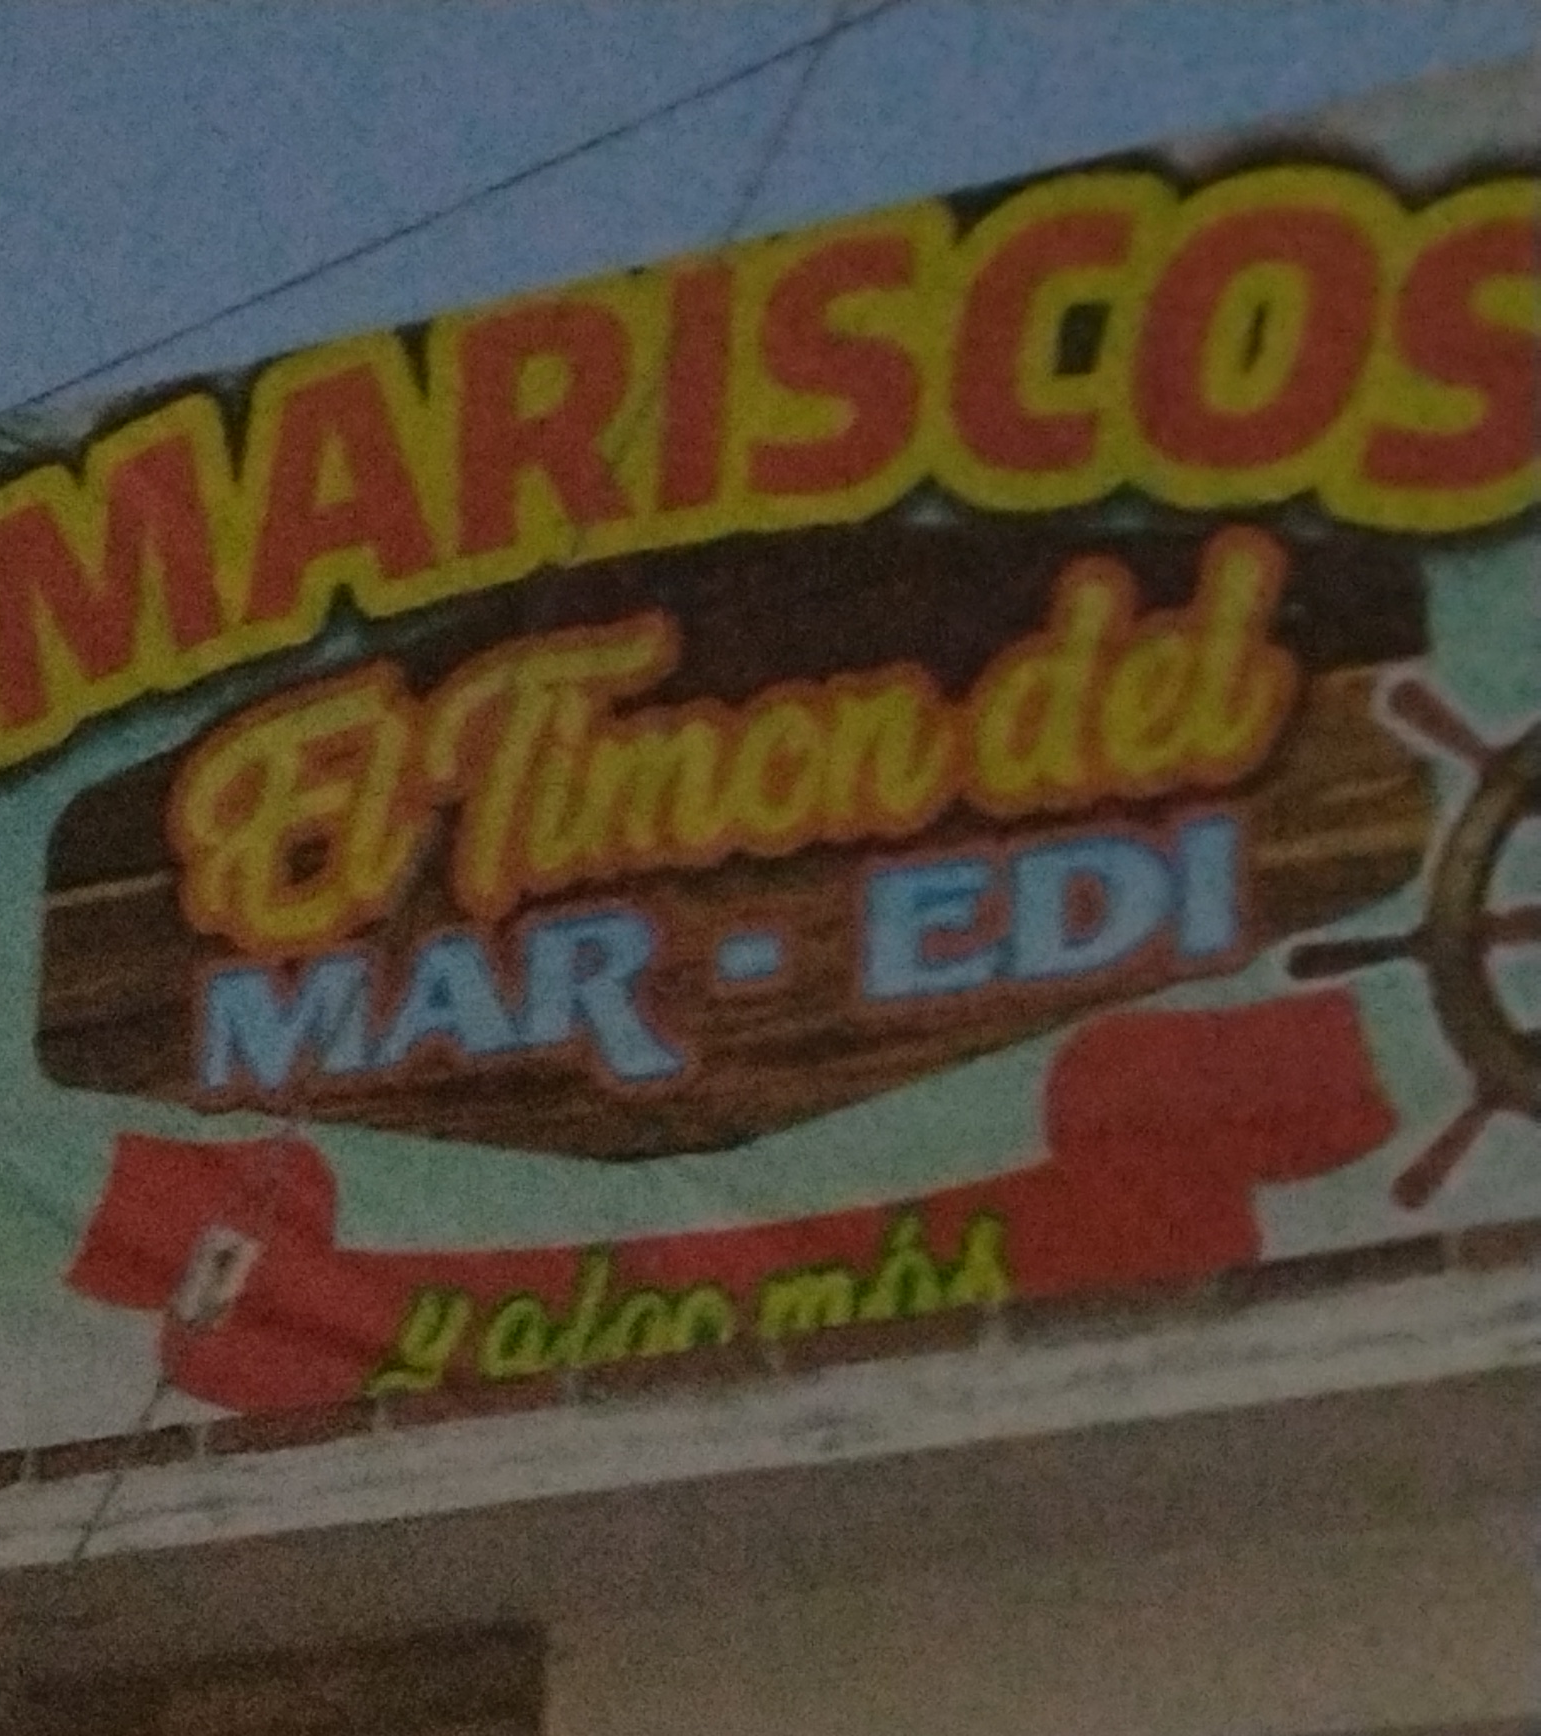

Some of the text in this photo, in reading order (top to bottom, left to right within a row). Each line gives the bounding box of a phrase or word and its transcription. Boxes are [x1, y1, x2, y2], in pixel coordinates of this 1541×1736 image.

[179, 545, 1279, 945] El Timon del
[201, 905, 687, 1090] MAR
[862, 812, 1242, 998] EDI
[363, 1285, 472, 1395] y
